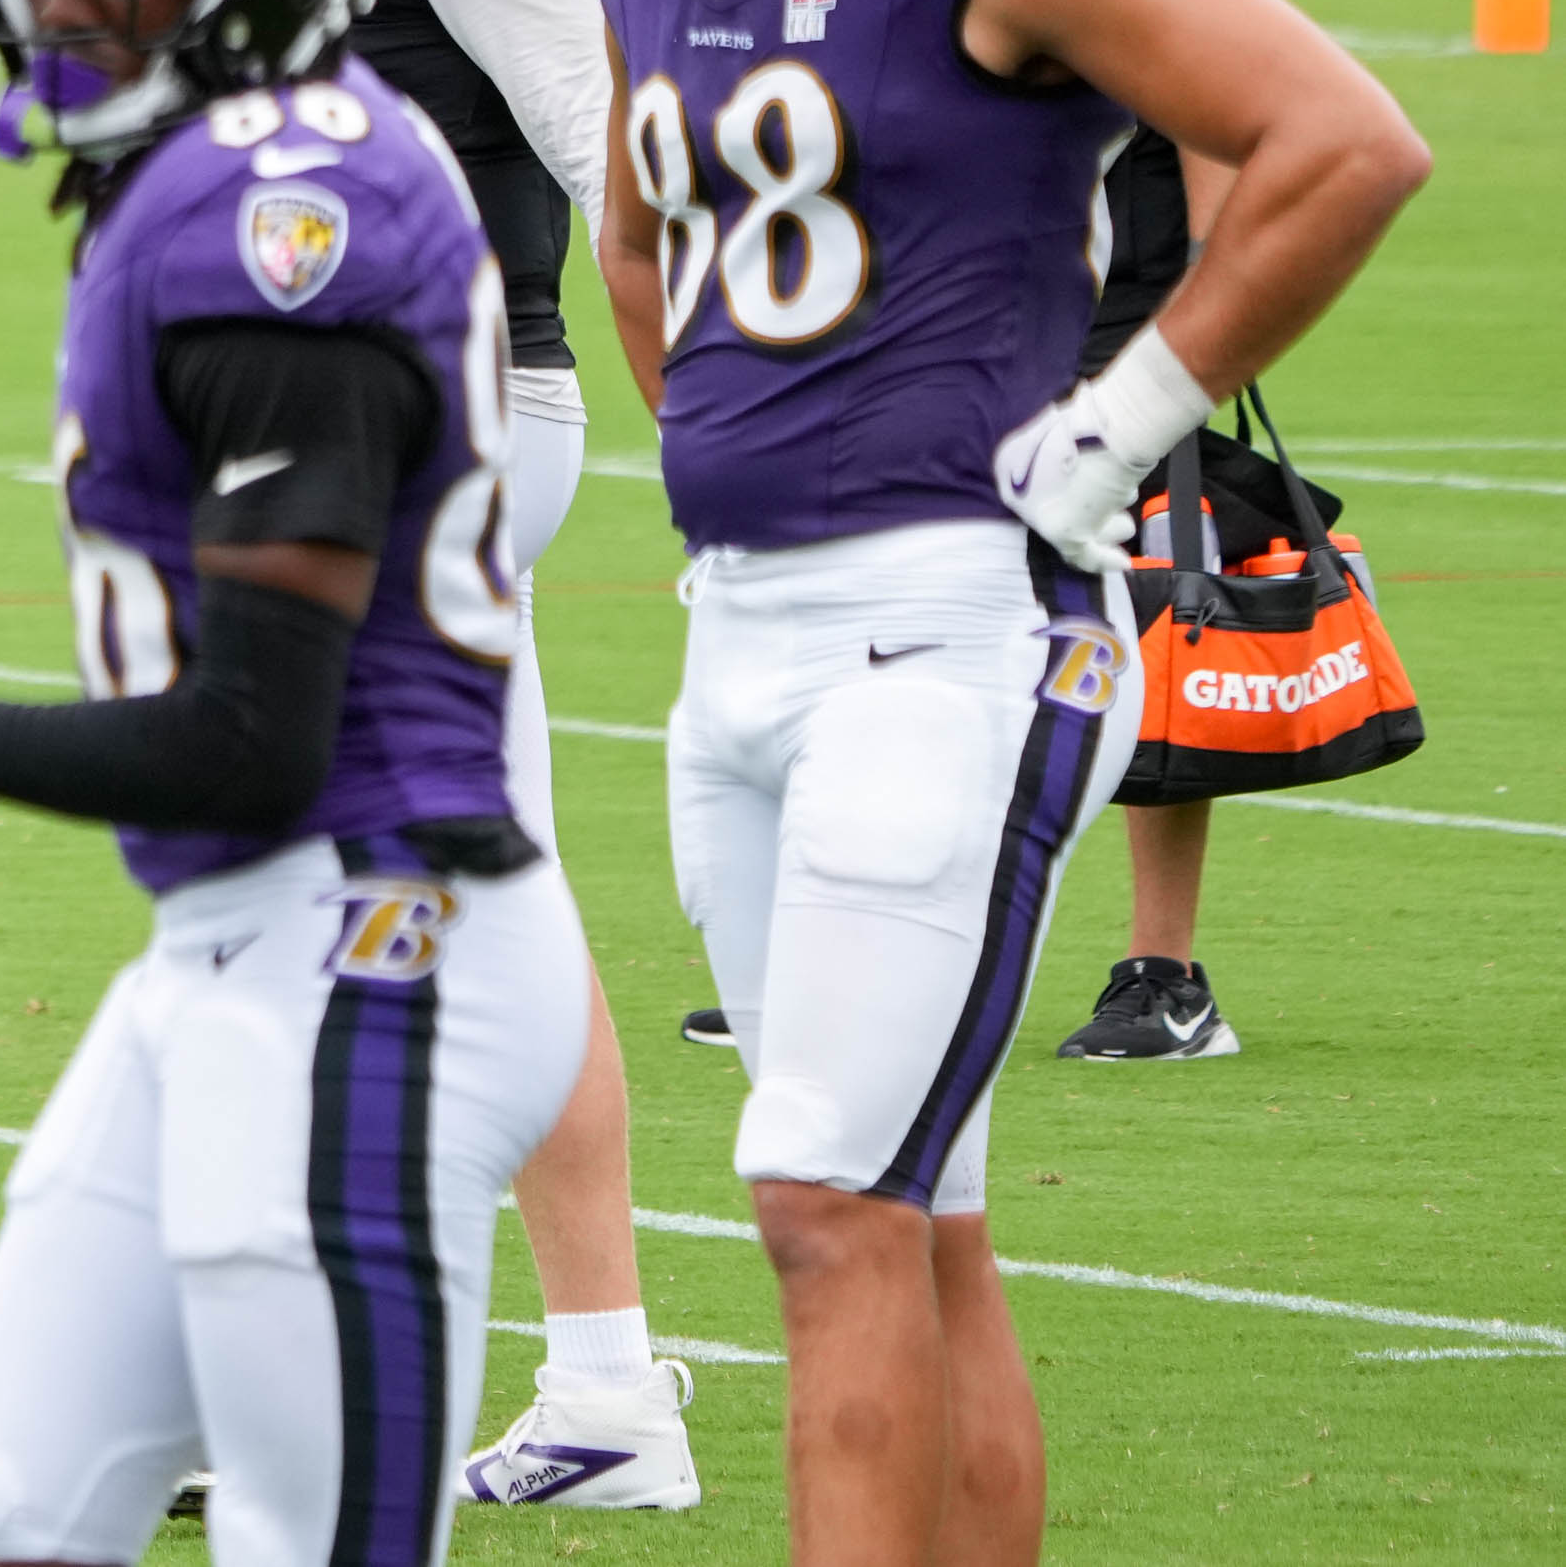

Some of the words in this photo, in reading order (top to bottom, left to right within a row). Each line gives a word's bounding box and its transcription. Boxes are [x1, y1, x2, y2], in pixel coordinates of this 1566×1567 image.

[688, 27, 755, 51] RAVENS
[628, 60, 868, 353] 88
[507, 1465, 569, 1500] ALPHA
